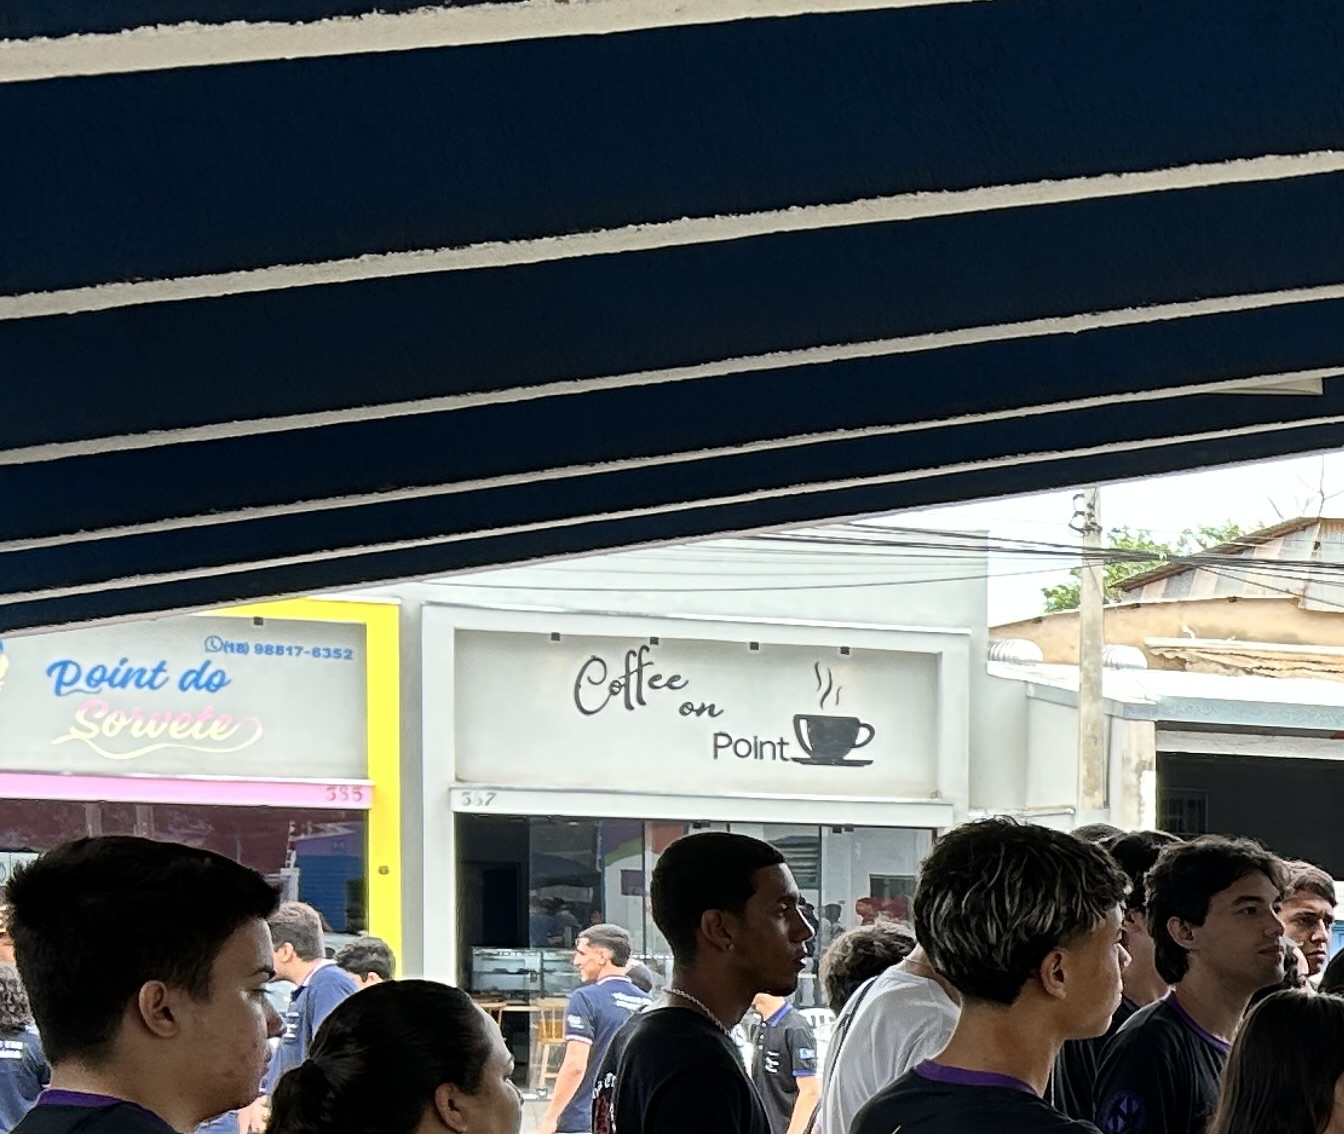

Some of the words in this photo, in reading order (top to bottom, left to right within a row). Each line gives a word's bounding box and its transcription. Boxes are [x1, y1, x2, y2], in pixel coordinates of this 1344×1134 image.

[223, 640, 249, 655] (18)
[46, 657, 170, 697] Point
[178, 659, 231, 693] do
[574, 645, 689, 716] Coffee
[52, 698, 262, 756] Sorvete
[678, 701, 724, 718] on
[713, 731, 790, 762] Point
